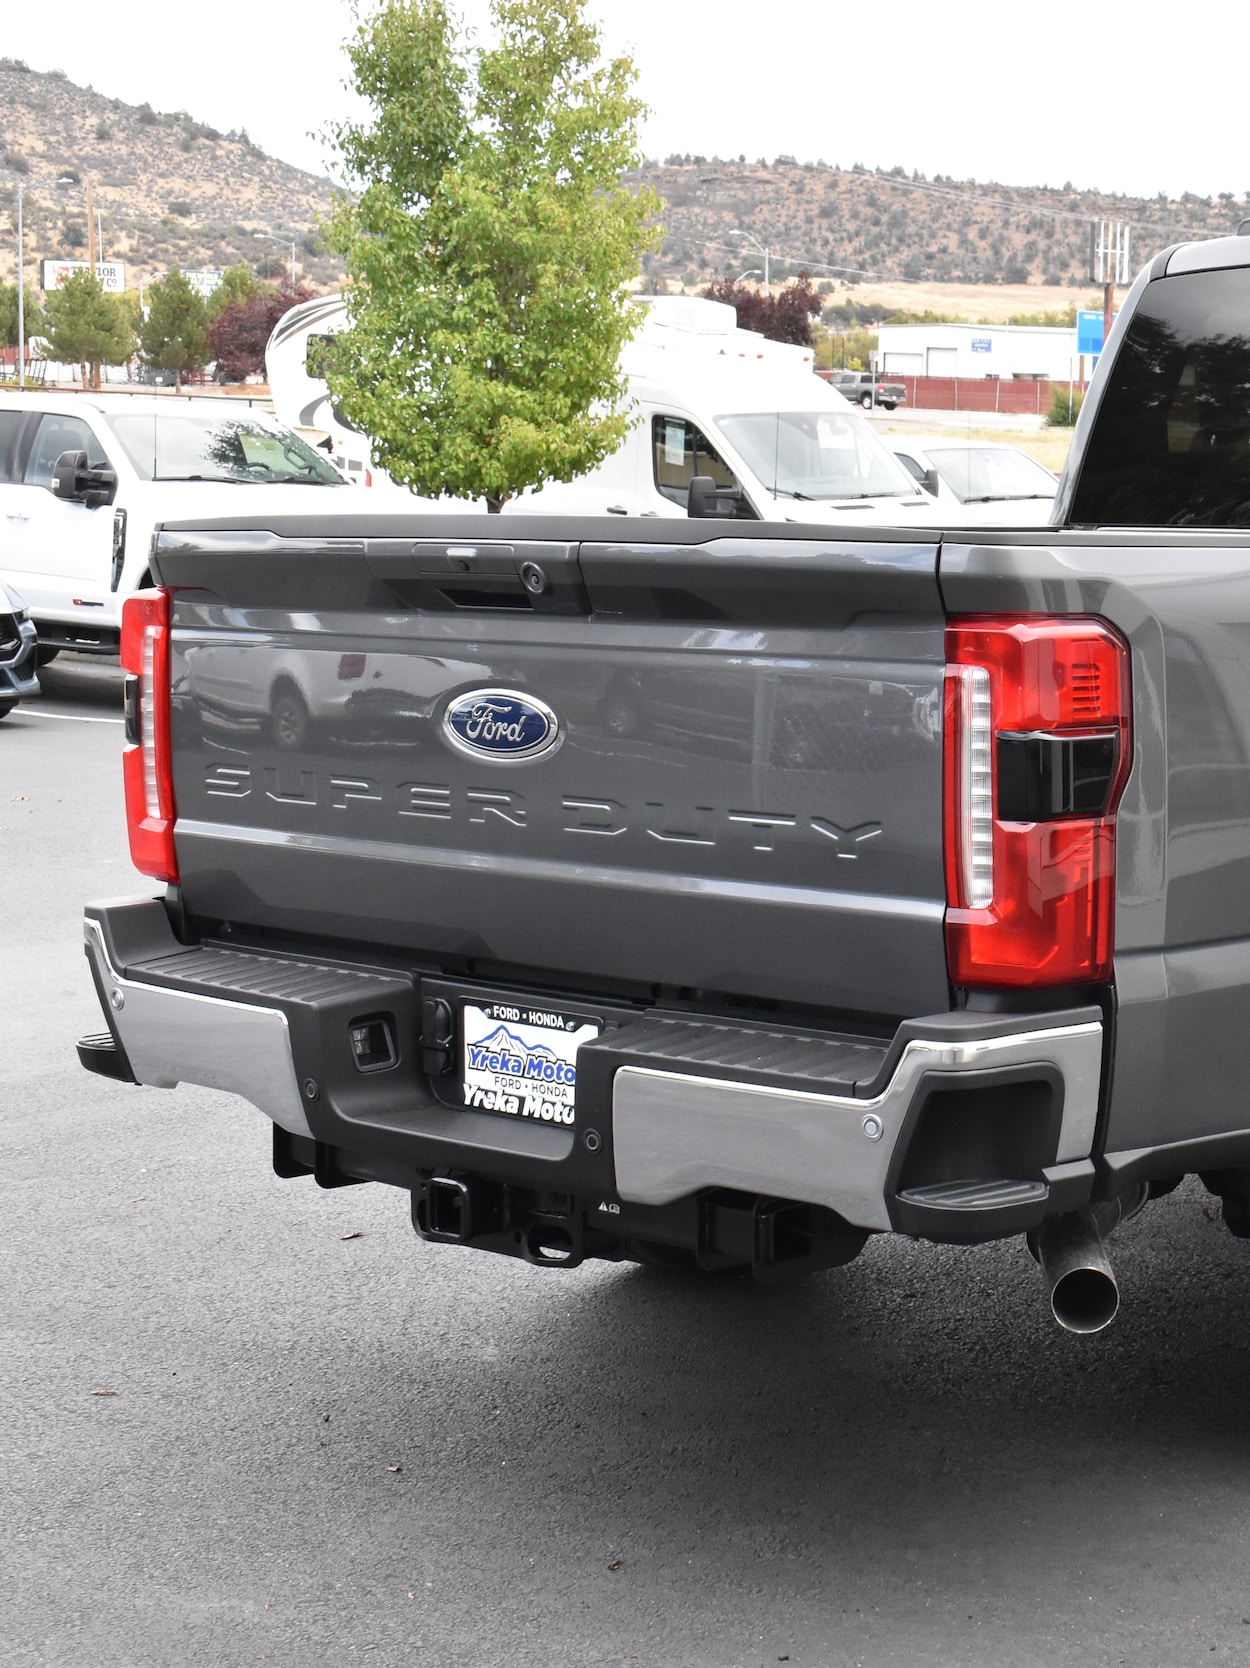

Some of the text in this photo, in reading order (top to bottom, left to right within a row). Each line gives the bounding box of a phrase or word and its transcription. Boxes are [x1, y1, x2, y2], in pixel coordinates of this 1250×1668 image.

[466, 702, 526, 743] Ford
[204, 762, 883, 858] SUPER DUTY
[493, 1005, 565, 1028] FORD HONDA
[468, 1046, 576, 1083] Yreka Moto
[463, 1083, 520, 1114] Yreka
[494, 1076, 568, 1098] FORD HONDA
